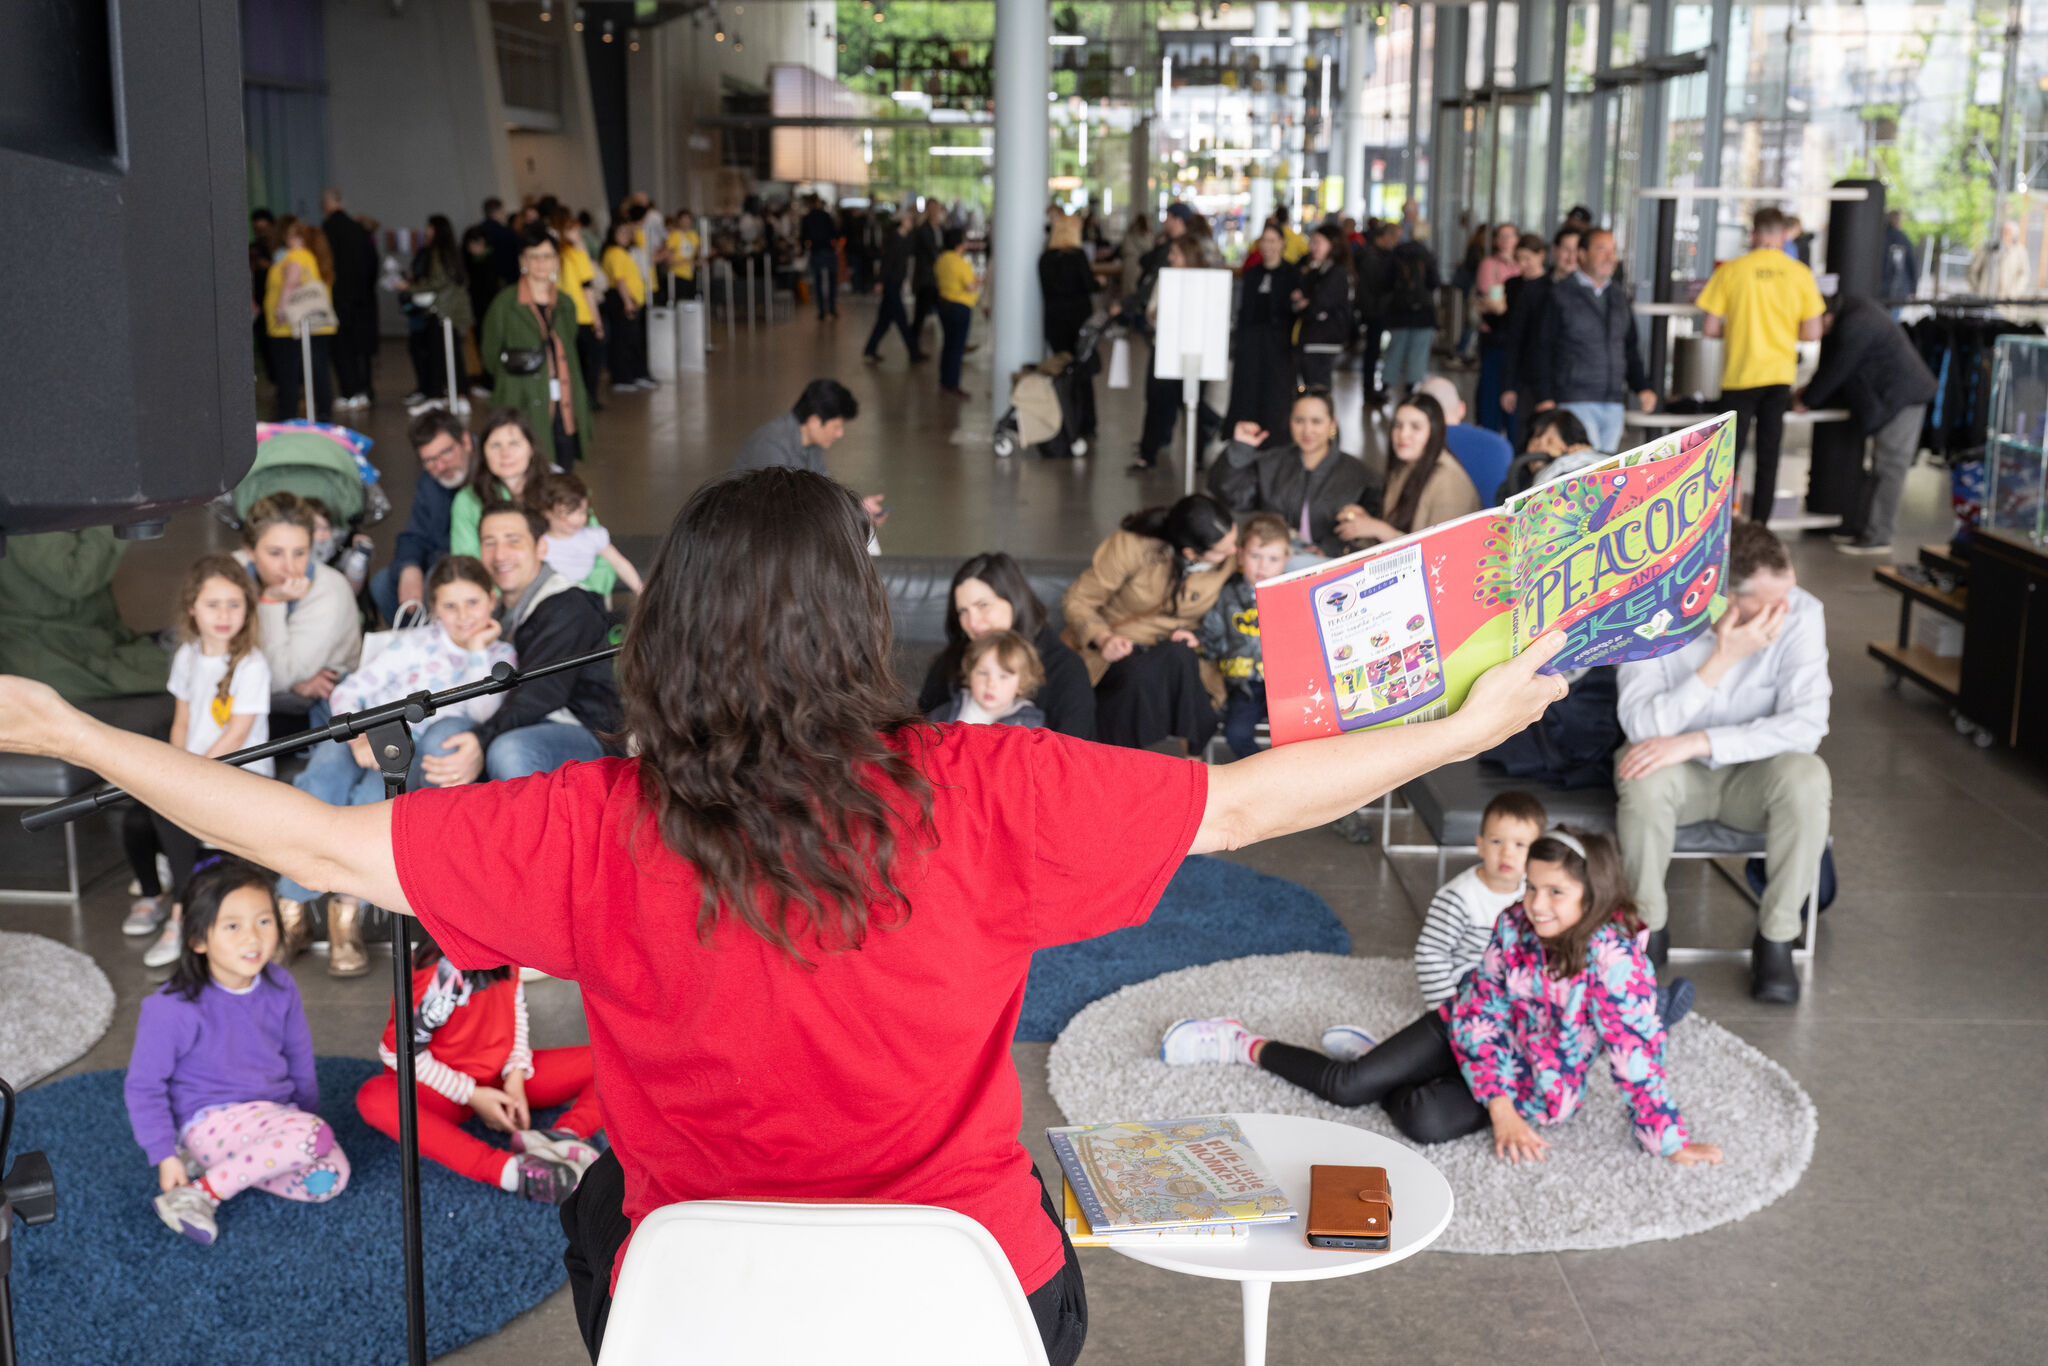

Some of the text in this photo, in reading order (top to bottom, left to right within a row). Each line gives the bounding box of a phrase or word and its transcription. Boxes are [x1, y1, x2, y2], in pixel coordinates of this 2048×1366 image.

[1525, 427, 1727, 638] PEACOCK
[1551, 505, 1726, 667] SKETCH
[1627, 564, 1663, 591] AND
[1184, 1143, 1253, 1193] MONKEYS
[1205, 1140, 1265, 1190] FIVE Little
